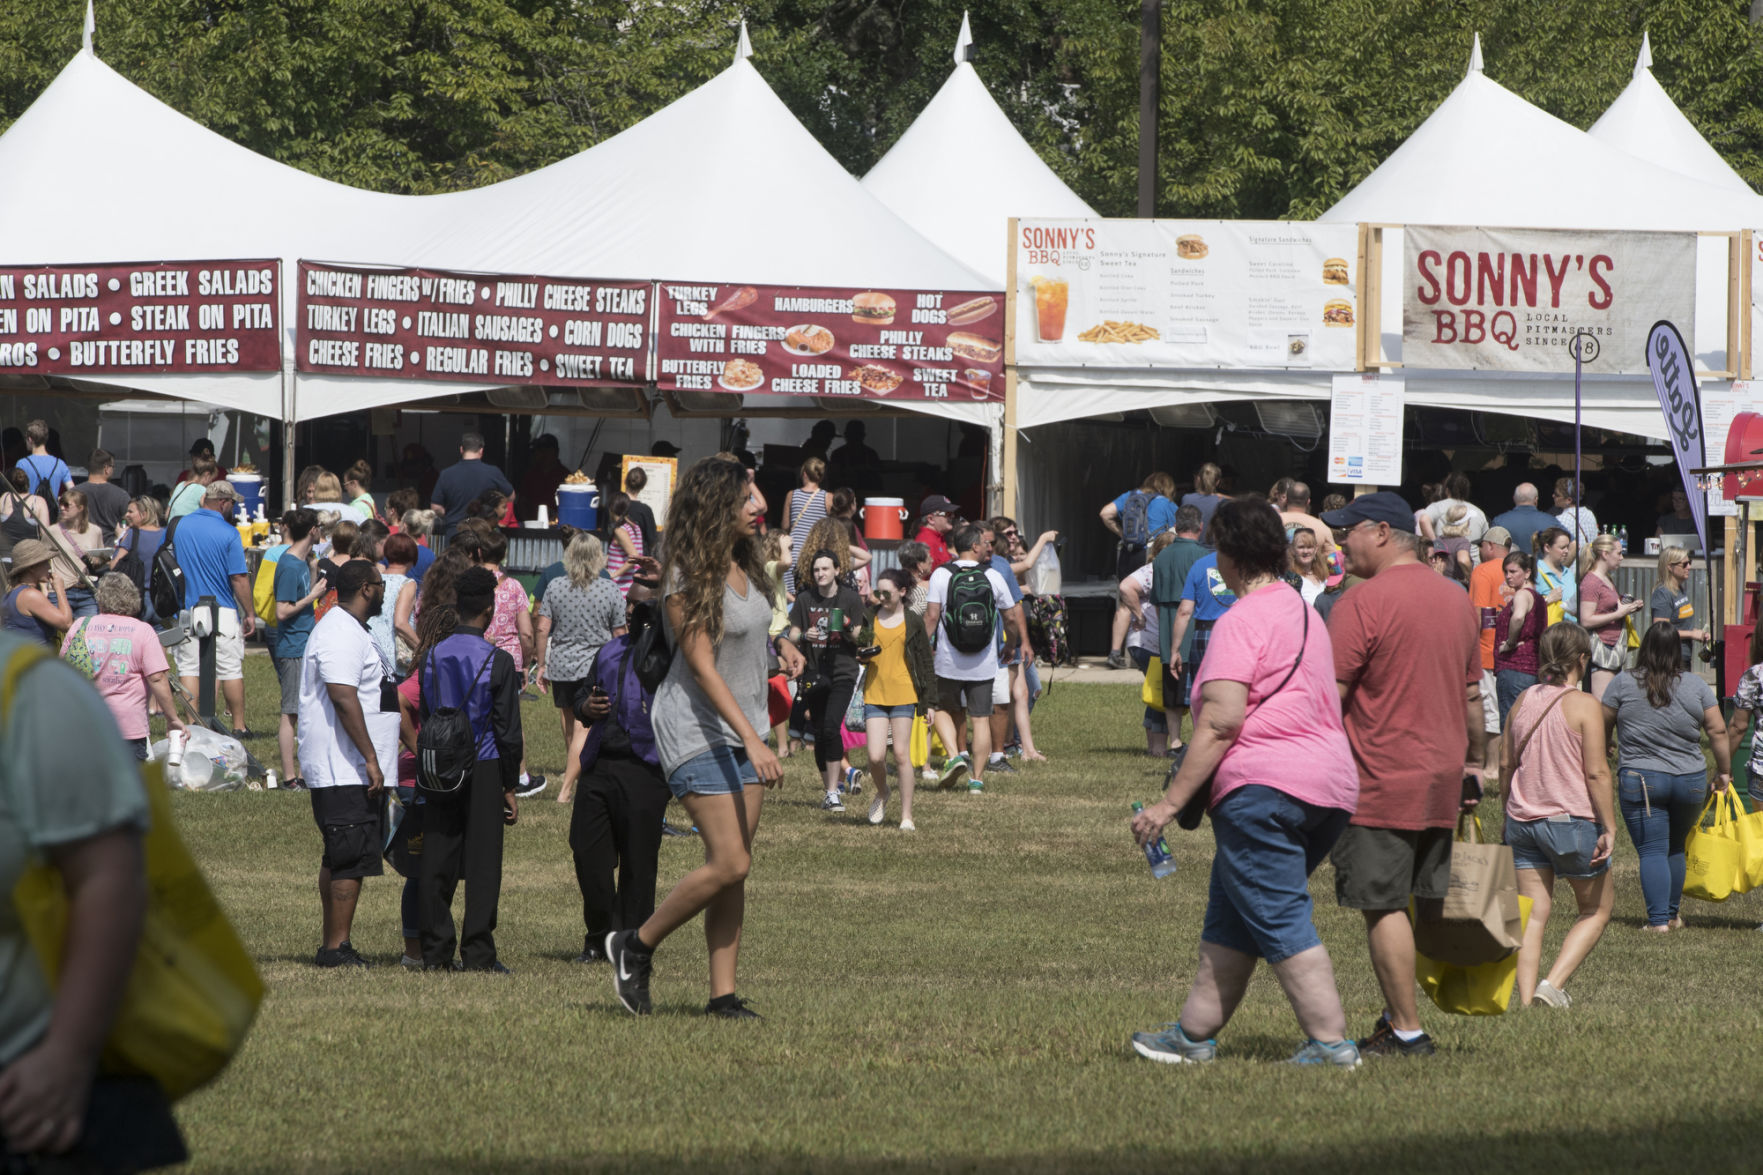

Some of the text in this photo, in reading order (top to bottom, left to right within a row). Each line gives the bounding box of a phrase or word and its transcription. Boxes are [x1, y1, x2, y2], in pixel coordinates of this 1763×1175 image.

[1022, 227, 1095, 250] SONNY'S
[1028, 250, 1061, 266] BBQ
[0, 270, 272, 299] N SALADS GREEK SALADS
[1418, 250, 1614, 310] SONNY'S
[307, 270, 362, 297] CHICKEN
[367, 275, 420, 301] FINGERS
[496, 283, 538, 308] PHILLY
[544, 285, 590, 311] CHEESE
[596, 287, 645, 314] STEAKS
[667, 286, 717, 302] TURKEY
[677, 301, 709, 316] LEGS
[775, 297, 854, 313] HAMBURGERS
[917, 294, 943, 308] HOT
[27, 308, 51, 333] ON
[61, 307, 99, 332] PITA
[131, 305, 189, 330] STEAK
[199, 305, 224, 329] ON
[233, 304, 272, 328] PITA
[912, 309, 947, 324] DOGS
[1526, 314, 1568, 322] LOCAL
[307, 305, 642, 348] TURKEY LEGS ITALIAN SAUSAGES CORN DOGS
[671, 323, 786, 341] CHICKEN FINGERS
[1431, 310, 1519, 350] BBQ
[1526, 326, 1613, 335] PITMASTERS
[880, 330, 923, 346] PHILLY
[1526, 338, 1567, 346] SINCE
[70, 340, 174, 365] BUTTERFLY
[186, 339, 238, 363] FRIES
[690, 339, 767, 354] WITH FRIES
[849, 344, 953, 361] CHEESE STEAKS
[309, 340, 636, 380] CHEESE FRIES REGULAR FRIES SWEET TEA
[662, 360, 726, 376] BUTTERFLY
[792, 364, 841, 378] LOADED
[913, 368, 958, 382] SWEET
[676, 375, 712, 389] FRIES
[772, 378, 861, 394] CHEESE FRIES
[923, 383, 947, 397] TEA
